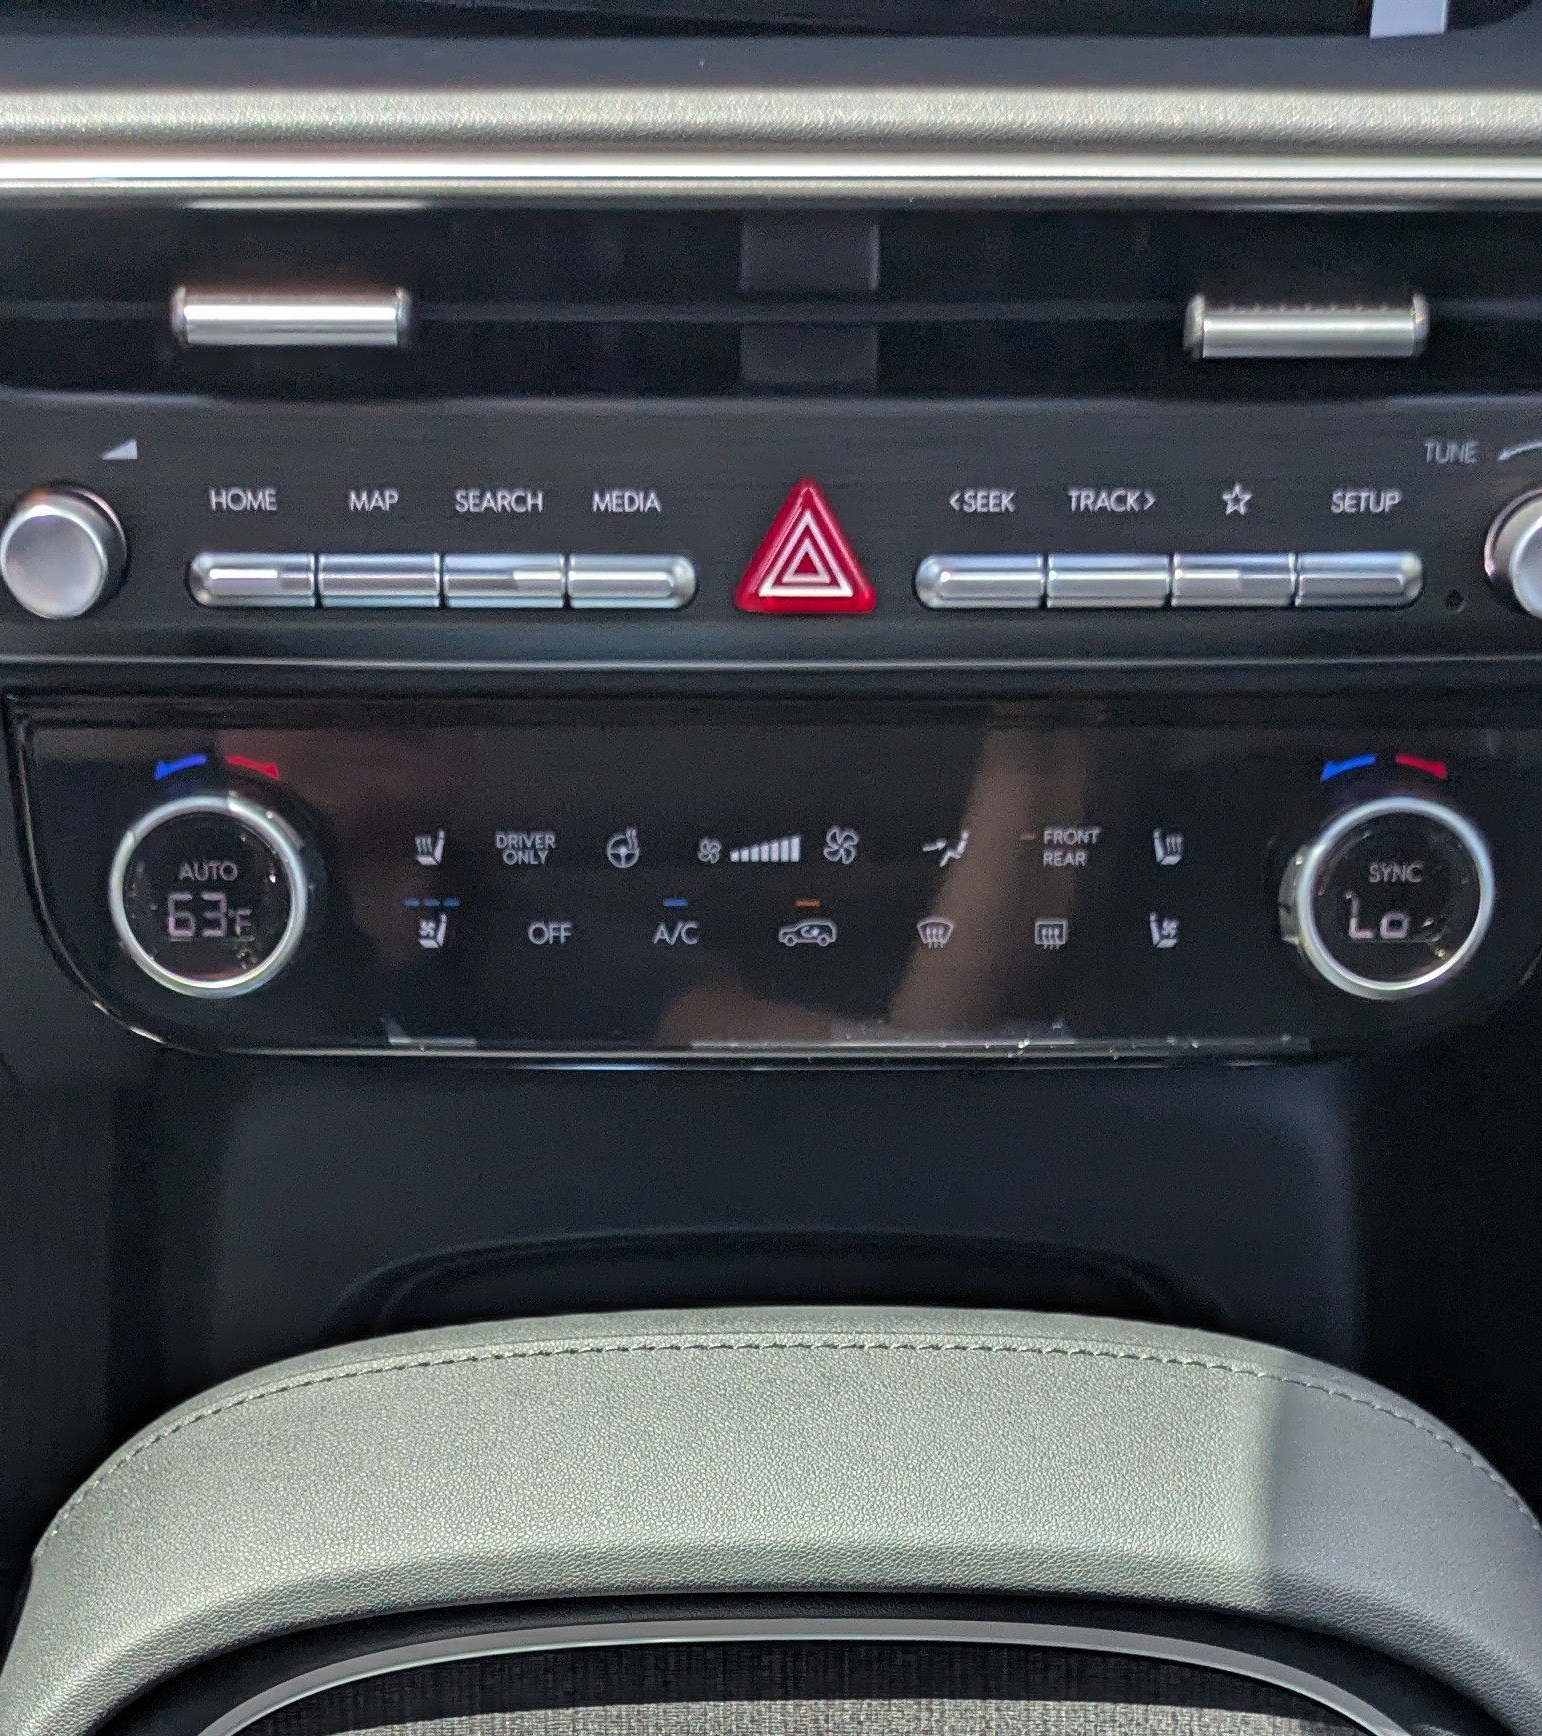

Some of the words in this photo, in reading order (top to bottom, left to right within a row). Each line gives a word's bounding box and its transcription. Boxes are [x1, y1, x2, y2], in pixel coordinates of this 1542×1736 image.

[1423, 439, 1479, 464] TUNE
[209, 488, 277, 512] HOME
[349, 489, 399, 513] MAP
[455, 490, 544, 513] SEARCH
[592, 489, 661, 513] MEDIA
[1330, 488, 1402, 513] SETUP
[495, 831, 556, 849] DRIVER
[1042, 827, 1101, 845] FRONT
[502, 848, 549, 866] ONLY
[1041, 848, 1088, 867] REAR
[178, 860, 239, 881] AUTO
[1368, 861, 1423, 883] SYNC
[527, 921, 573, 945] OFF
[653, 919, 700, 946] A/C
